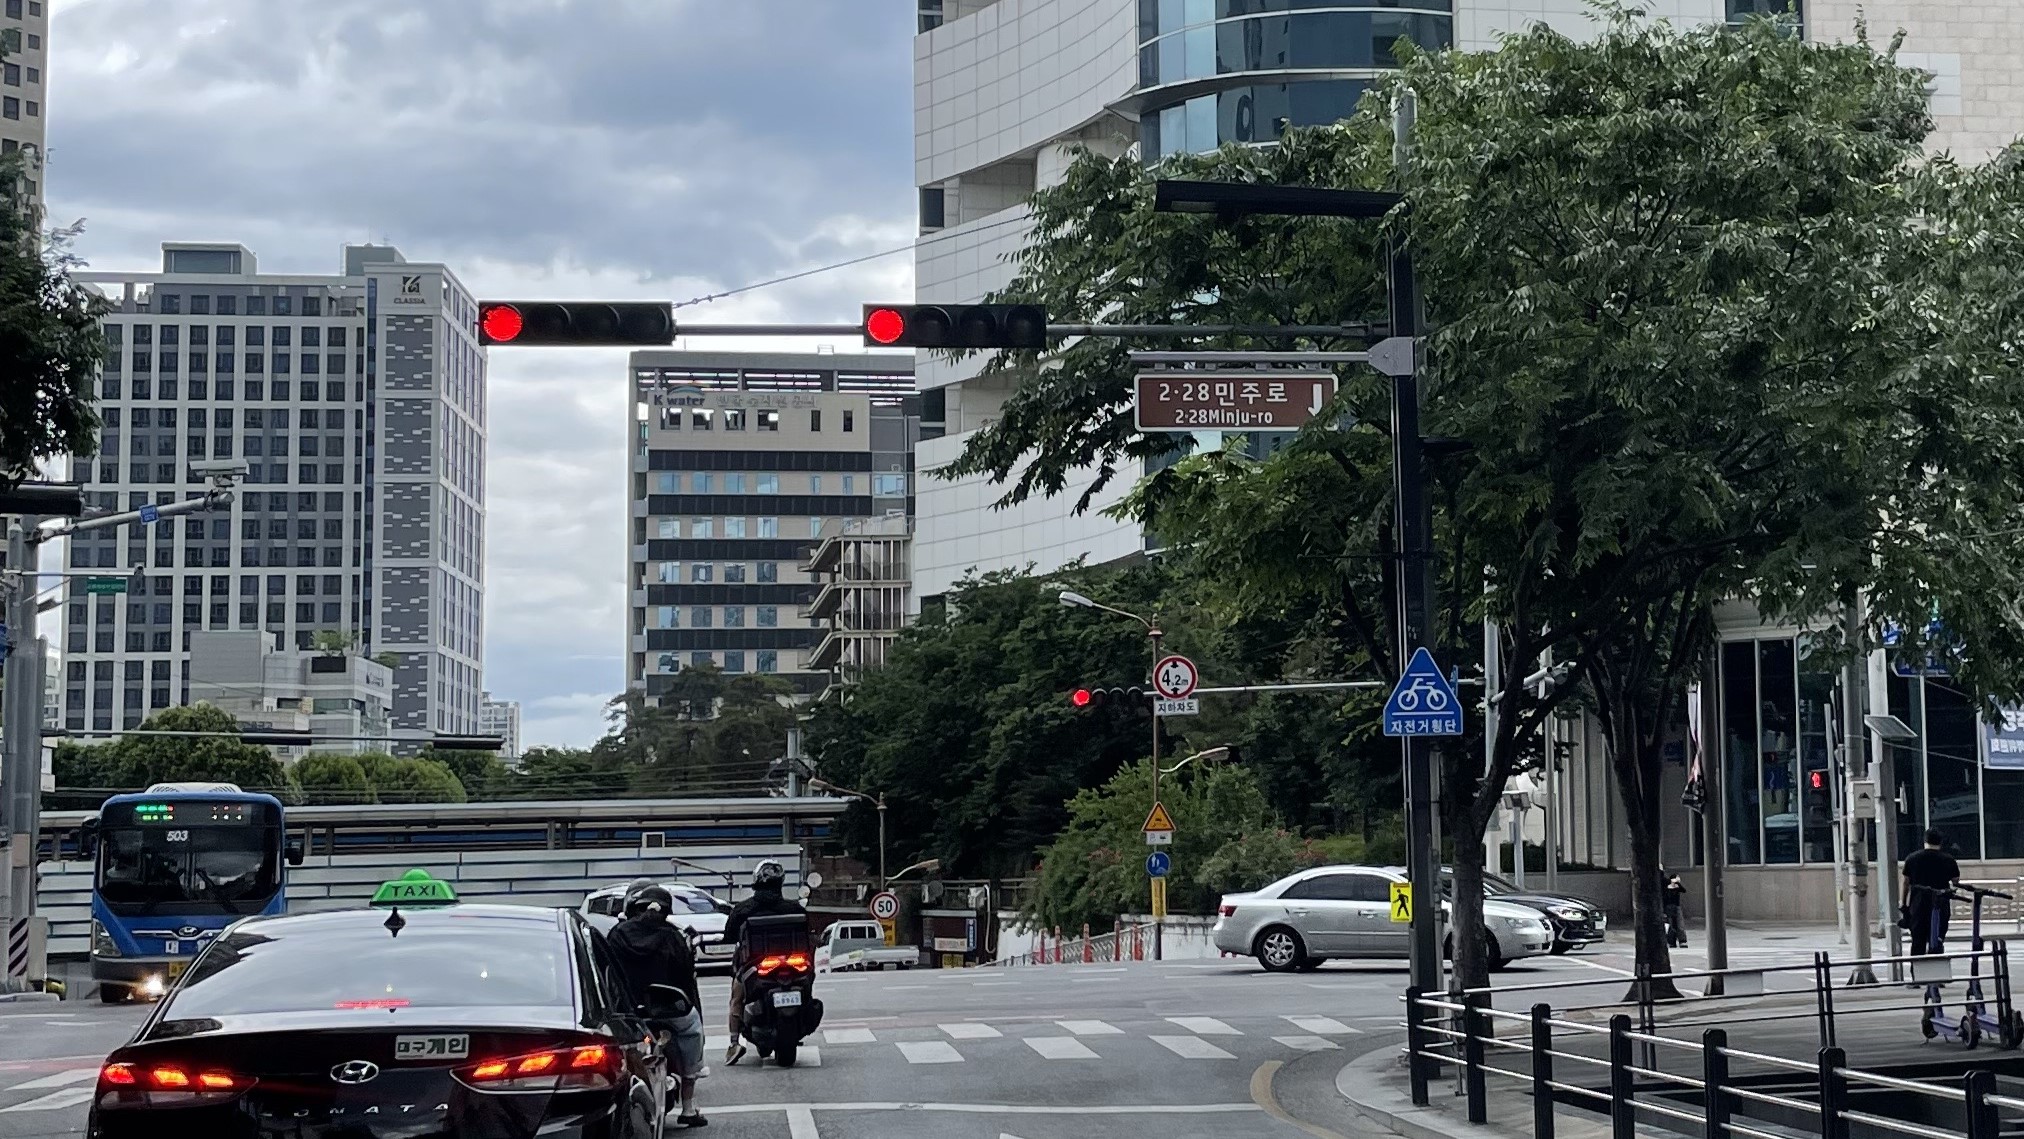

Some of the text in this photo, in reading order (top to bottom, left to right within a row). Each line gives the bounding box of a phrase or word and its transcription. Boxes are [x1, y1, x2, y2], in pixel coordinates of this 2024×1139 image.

[1158, 382, 1289, 407] 2·28민주로
[1157, 701, 1196, 713] 지하차도
[1390, 718, 1457, 734] 자전거횡단
[165, 829, 189, 842] 503
[391, 884, 436, 898] TAXI
[877, 899, 893, 913] 50
